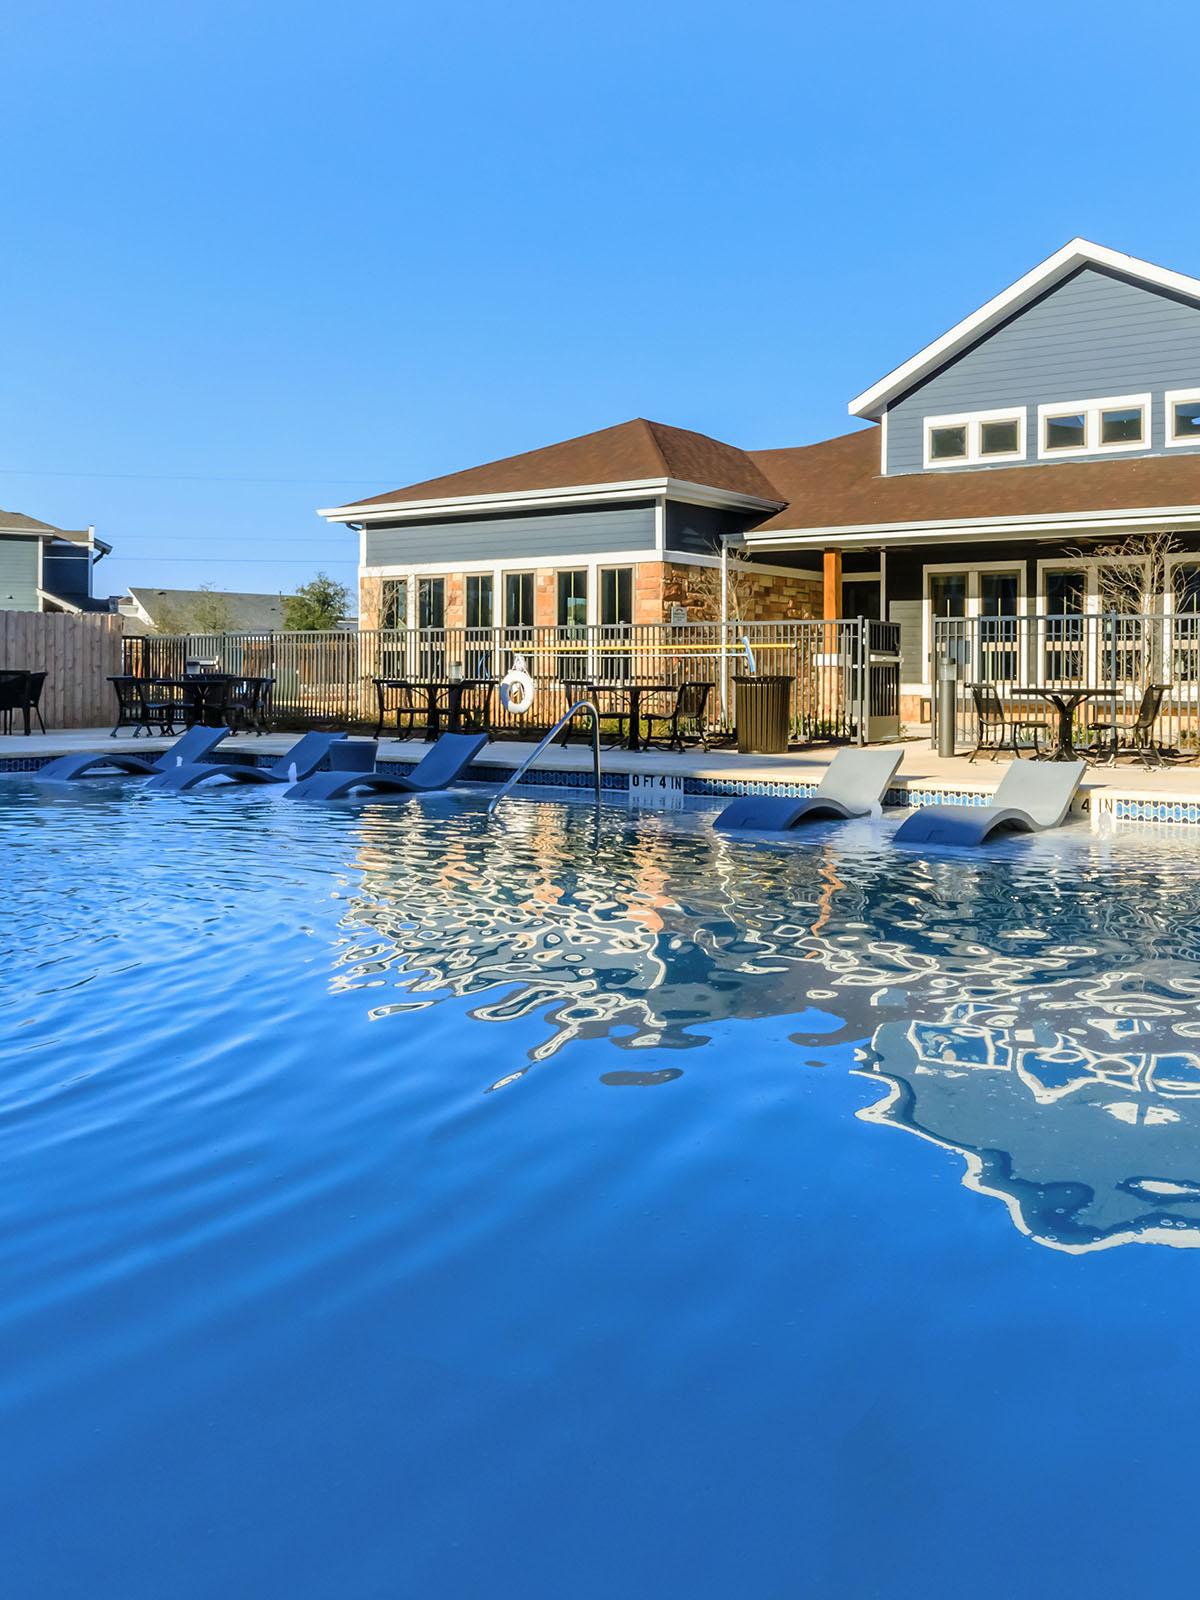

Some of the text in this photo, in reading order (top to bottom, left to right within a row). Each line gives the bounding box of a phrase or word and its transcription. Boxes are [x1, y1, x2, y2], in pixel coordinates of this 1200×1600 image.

[644, 776, 654, 788] FT
[660, 776, 666, 788] 4
[672, 777, 681, 789] IN
[1081, 798, 1091, 813] 4
[1099, 798, 1113, 814] IN
